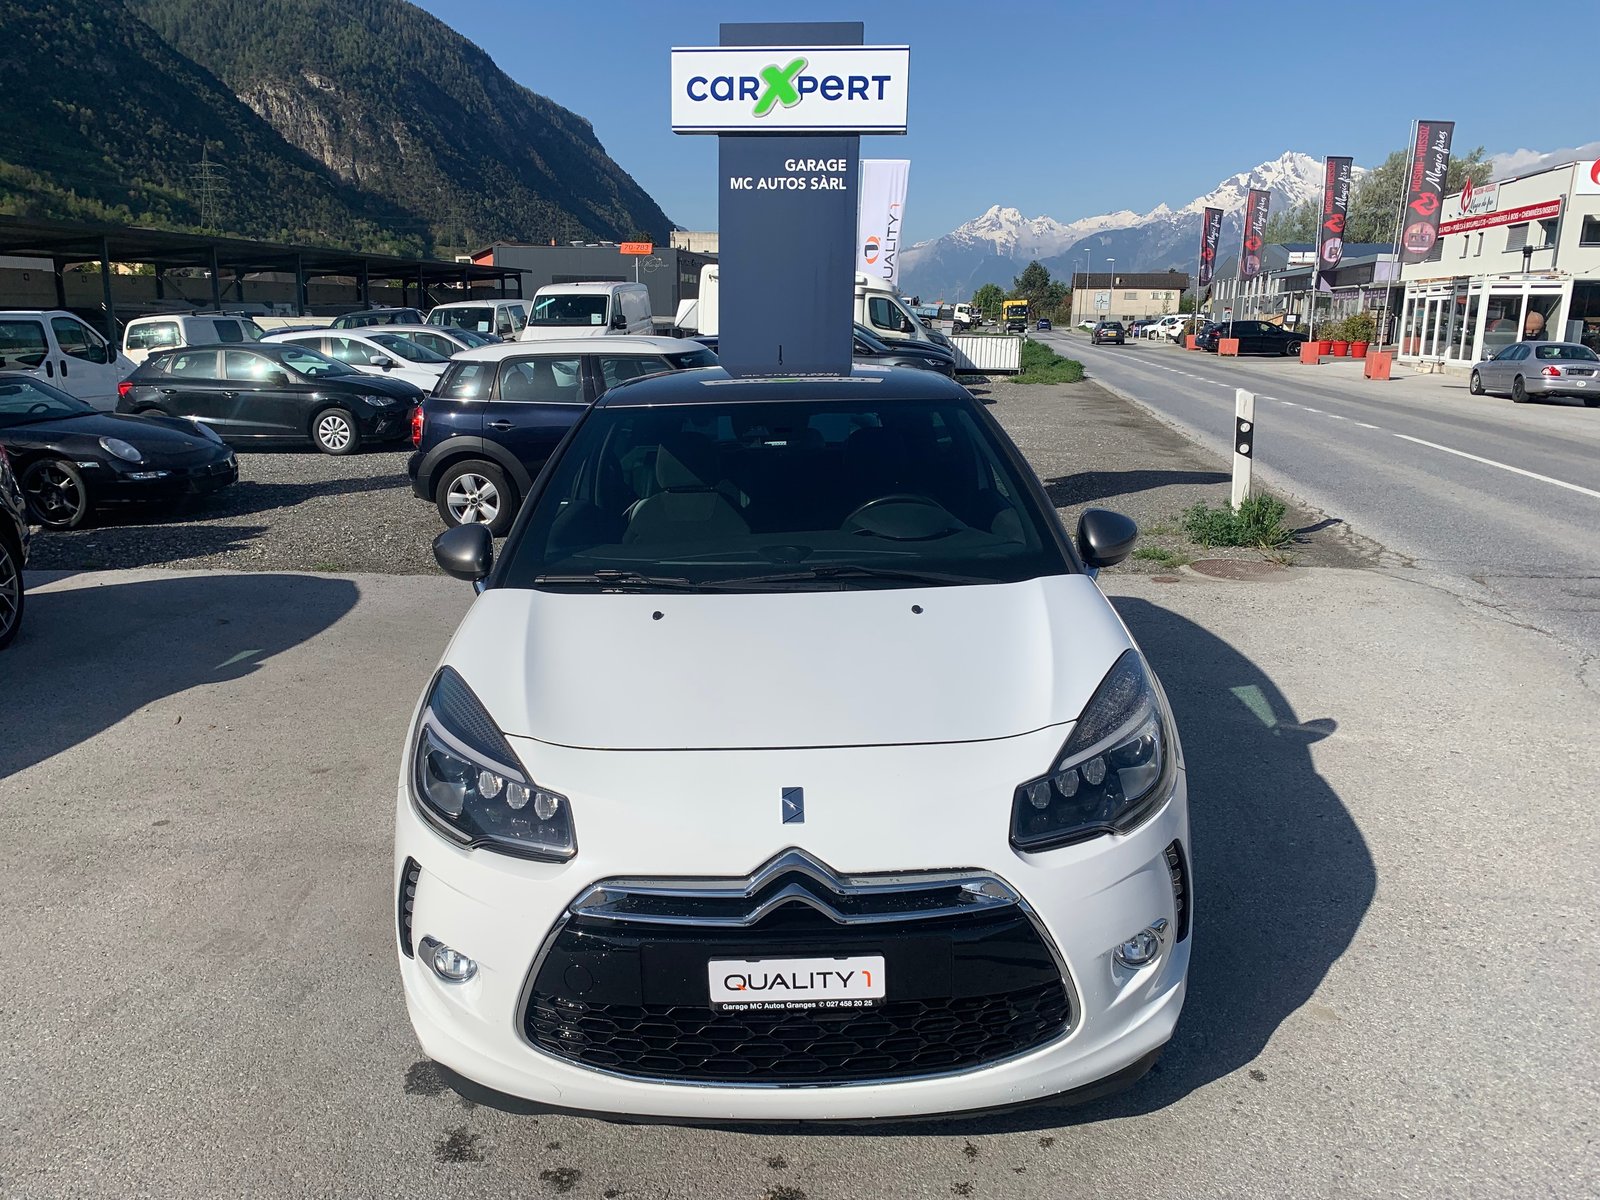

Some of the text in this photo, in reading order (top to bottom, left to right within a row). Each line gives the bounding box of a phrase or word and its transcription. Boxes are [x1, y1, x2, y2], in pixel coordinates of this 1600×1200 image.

[784, 159, 847, 172] GARAGE
[1411, 125, 1430, 192] MOSONI-VUISSOZ
[1425, 130, 1450, 192] Magic fires
[729, 174, 847, 190] MC AUTOS SÀRL
[883, 213, 899, 283] UALITY
[723, 970, 872, 991] QUALITY 1
[722, 1003, 749, 1011] Garage
[750, 1002, 763, 1010] MC
[764, 1002, 785, 1010] Autos
[786, 1001, 816, 1010] Granges
